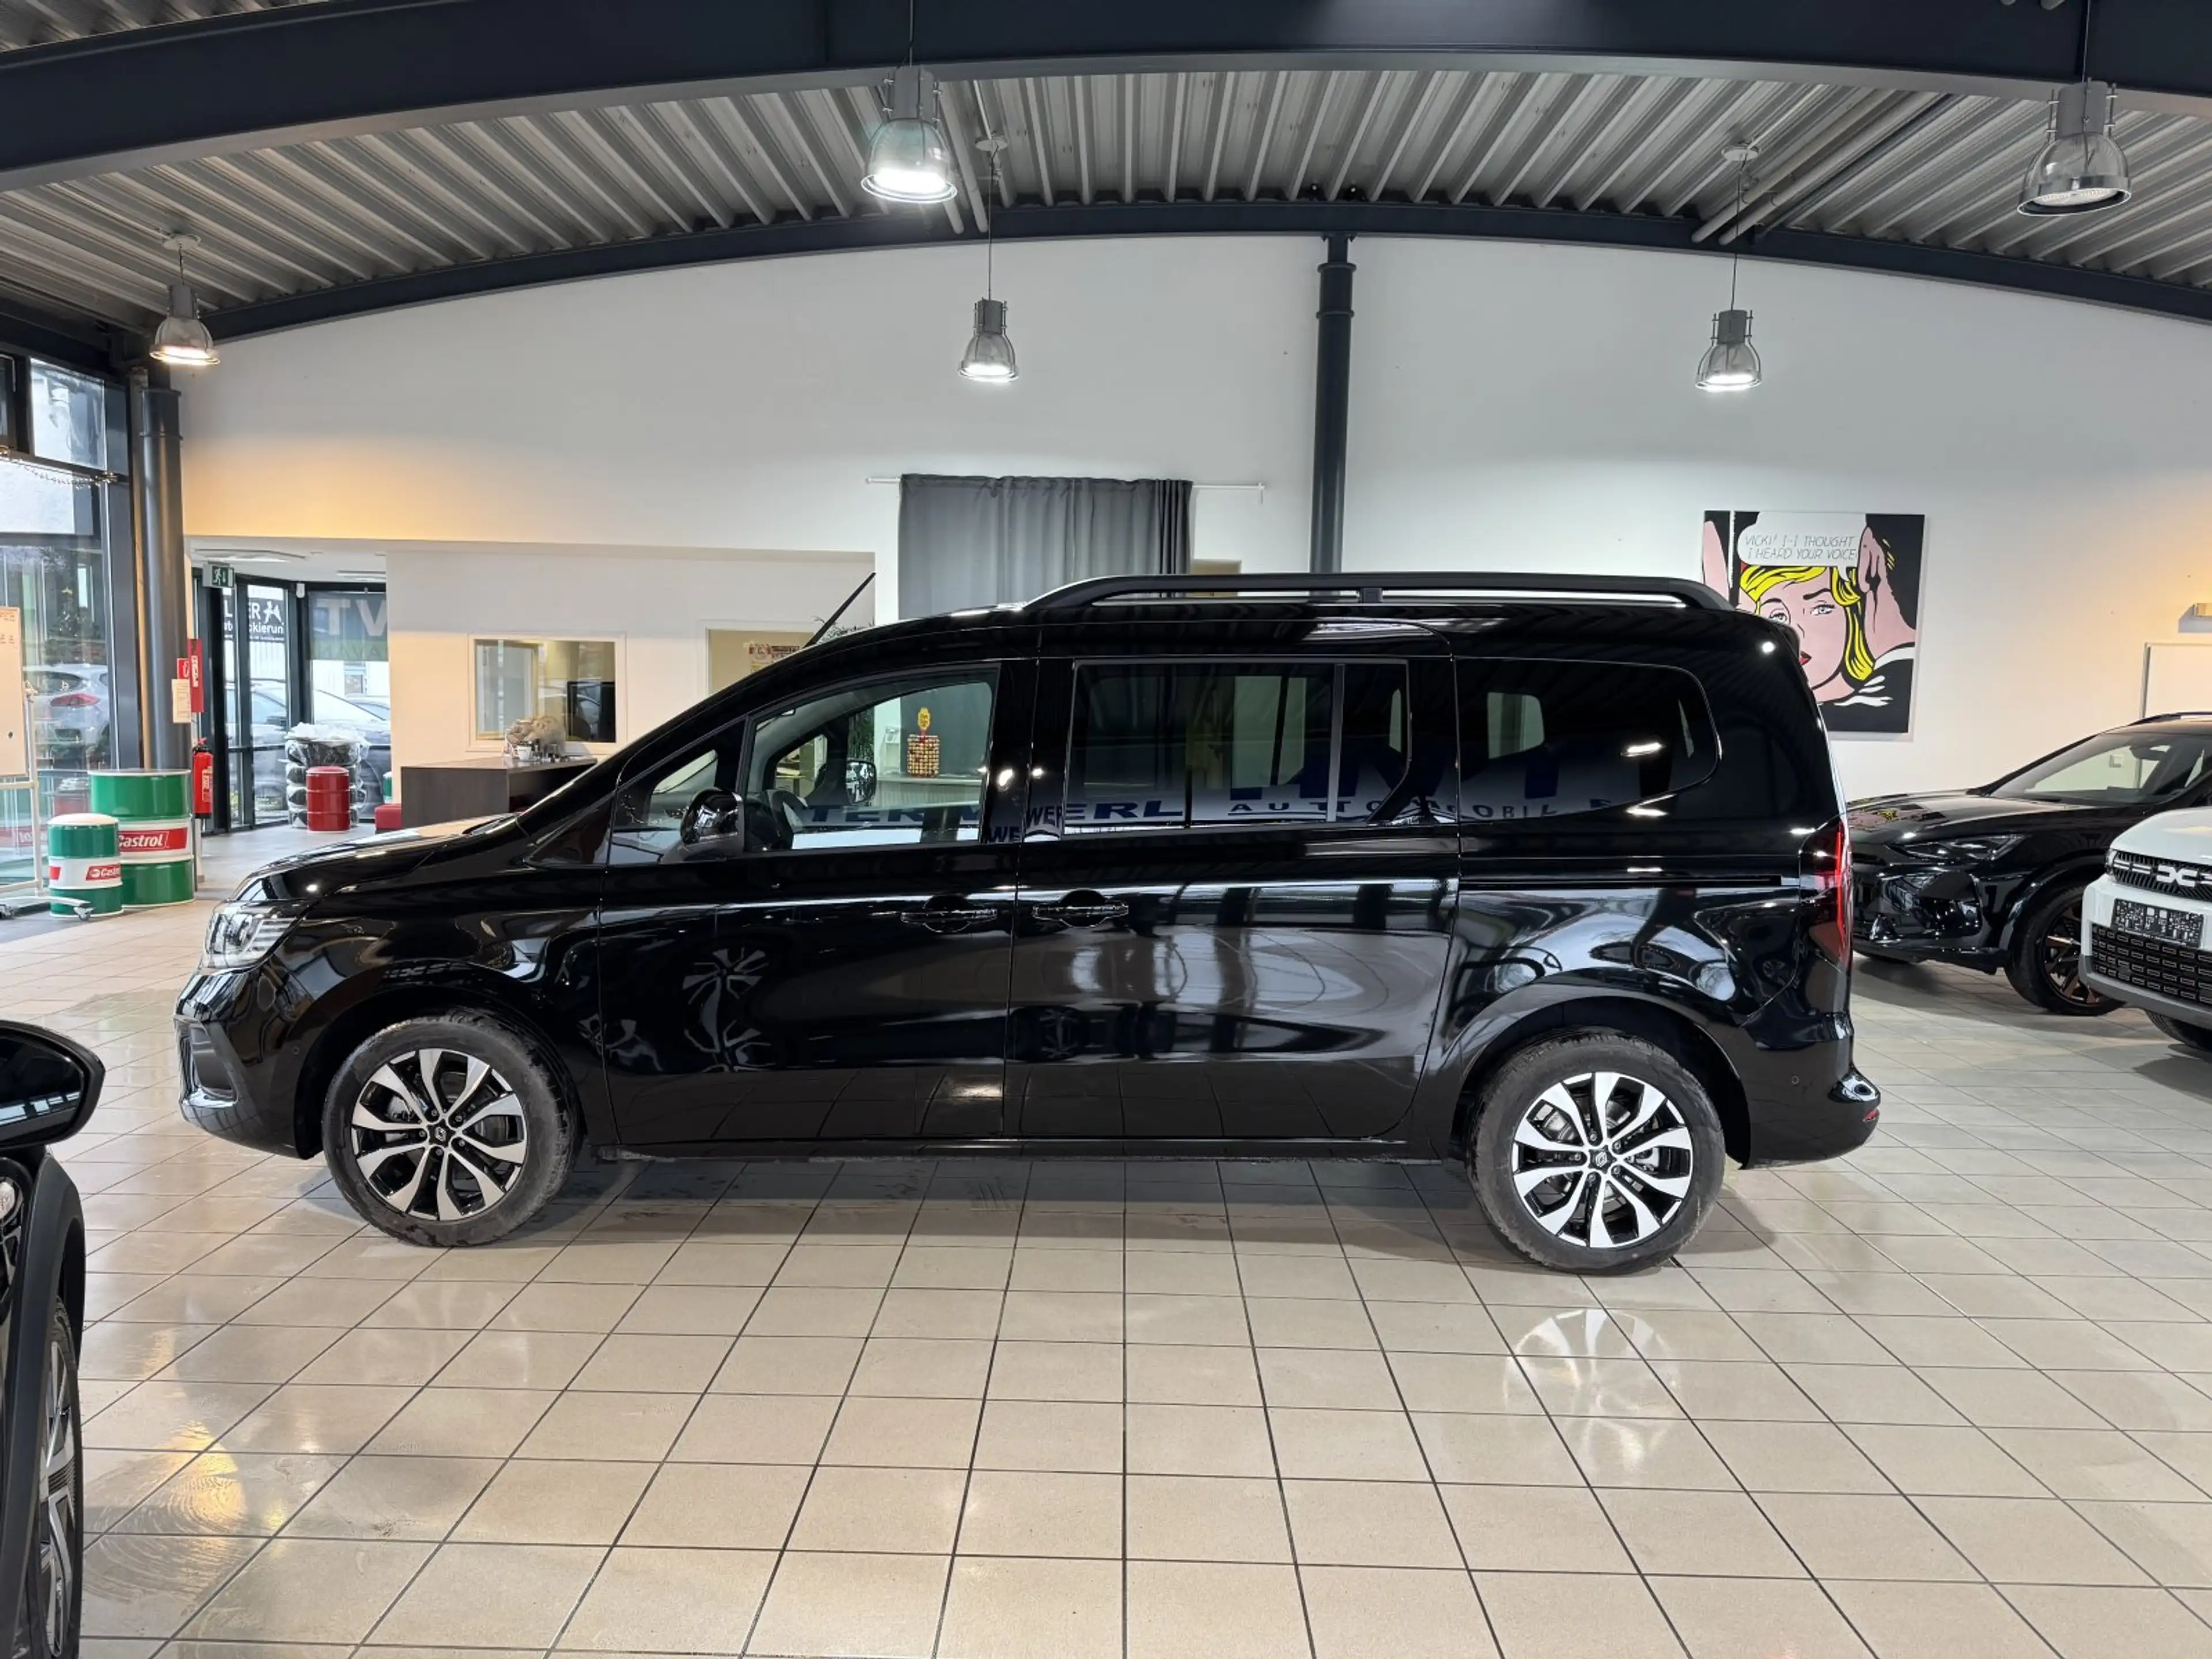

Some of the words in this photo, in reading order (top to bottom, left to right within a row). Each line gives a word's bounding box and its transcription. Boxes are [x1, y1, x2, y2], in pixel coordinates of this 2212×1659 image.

[1804, 536, 1855, 547] THOUGHT
[1756, 548, 1793, 559] HEARD
[1797, 548, 1823, 559] YOUR
